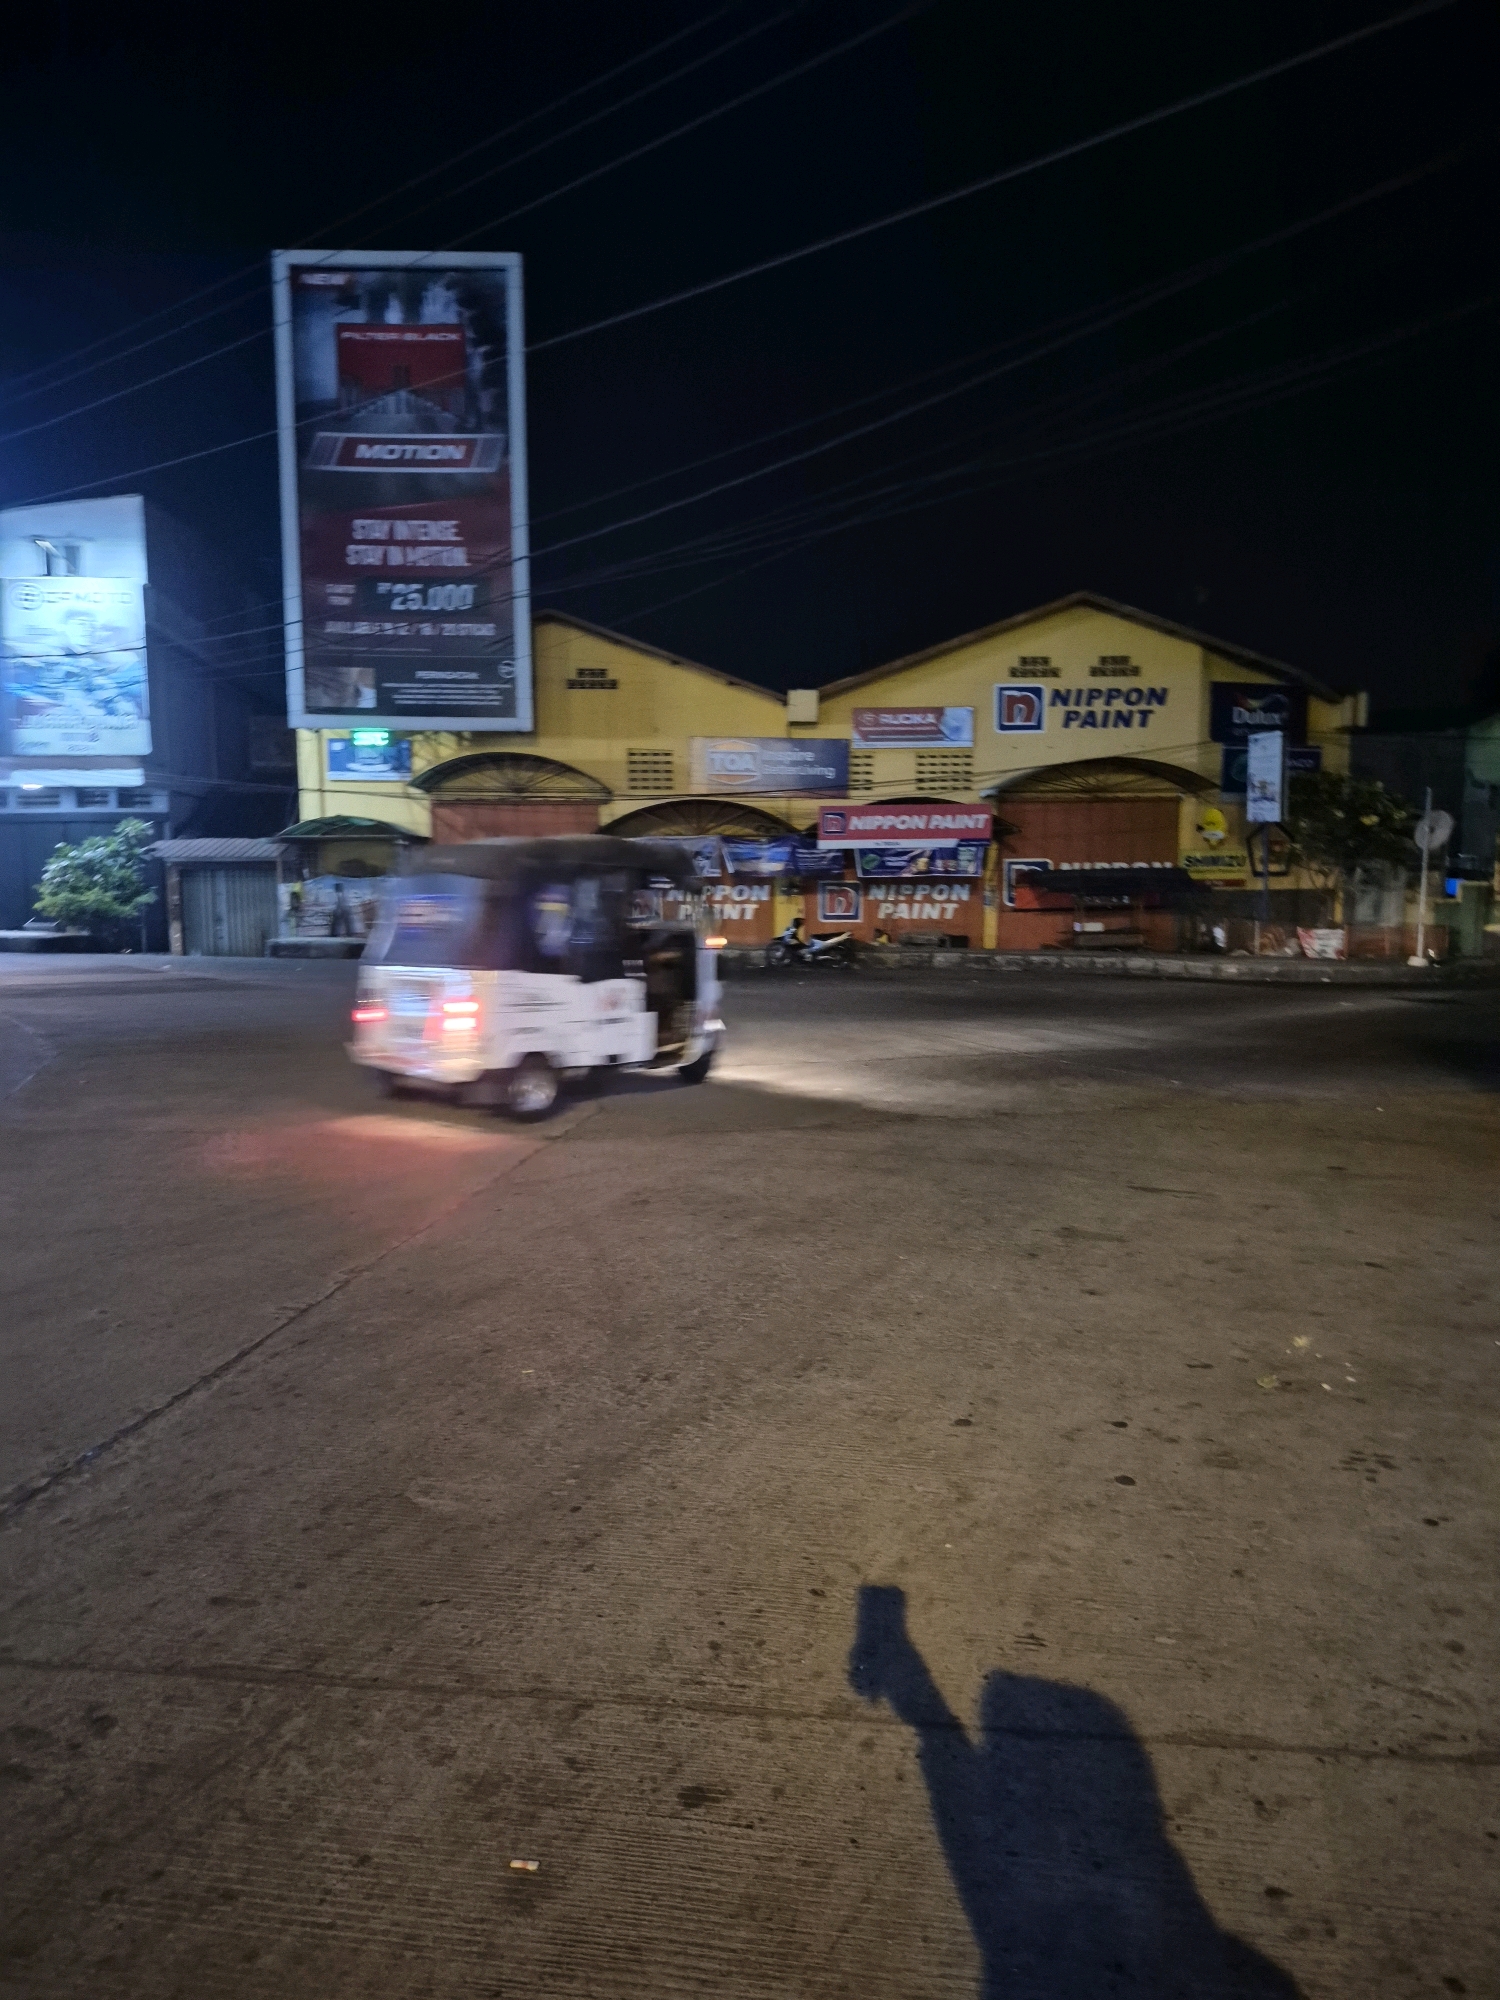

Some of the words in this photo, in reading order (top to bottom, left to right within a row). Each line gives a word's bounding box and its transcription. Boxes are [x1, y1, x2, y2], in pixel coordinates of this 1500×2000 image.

[354, 444, 467, 460] MOTION
[1048, 687, 1168, 708] NIPPON
[1061, 709, 1156, 729] PAINT
[1232, 705, 1283, 725] Dulux
[709, 753, 756, 772] TOA
[848, 815, 929, 831] NIPPON
[928, 813, 990, 830] PAINT
[867, 884, 971, 902] NIPPON
[876, 902, 961, 920] PAINT
